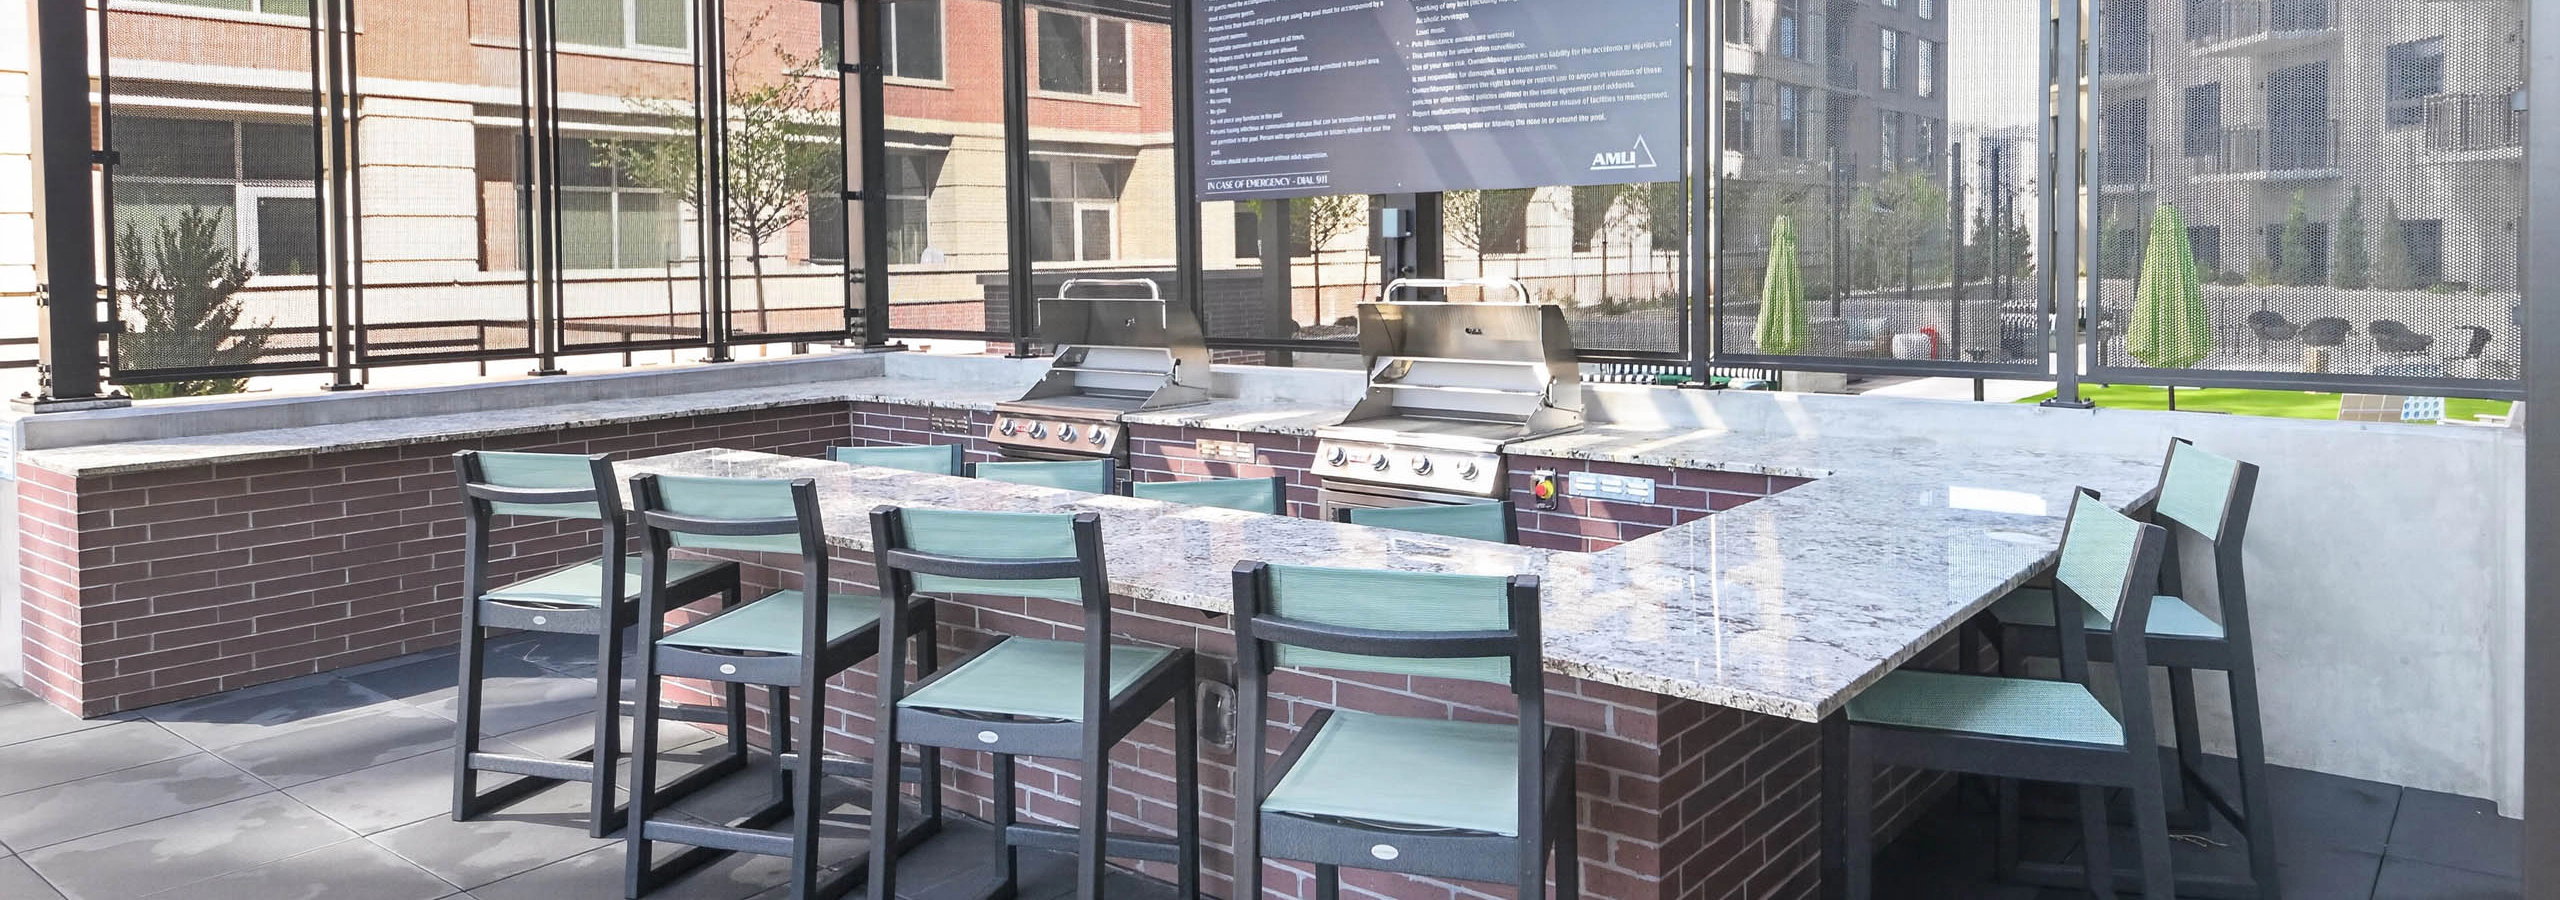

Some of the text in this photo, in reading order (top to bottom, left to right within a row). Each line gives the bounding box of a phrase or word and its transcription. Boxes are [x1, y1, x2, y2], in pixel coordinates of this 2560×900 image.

[1592, 151, 1636, 165] AMLI
[1207, 182, 1215, 190] IN
[1215, 180, 1233, 189] CASE
[1234, 179, 1244, 188] OF
[1246, 177, 1290, 188] EMERGENCY
[1297, 176, 1315, 185] DIAL
[1315, 174, 1328, 184] 911
